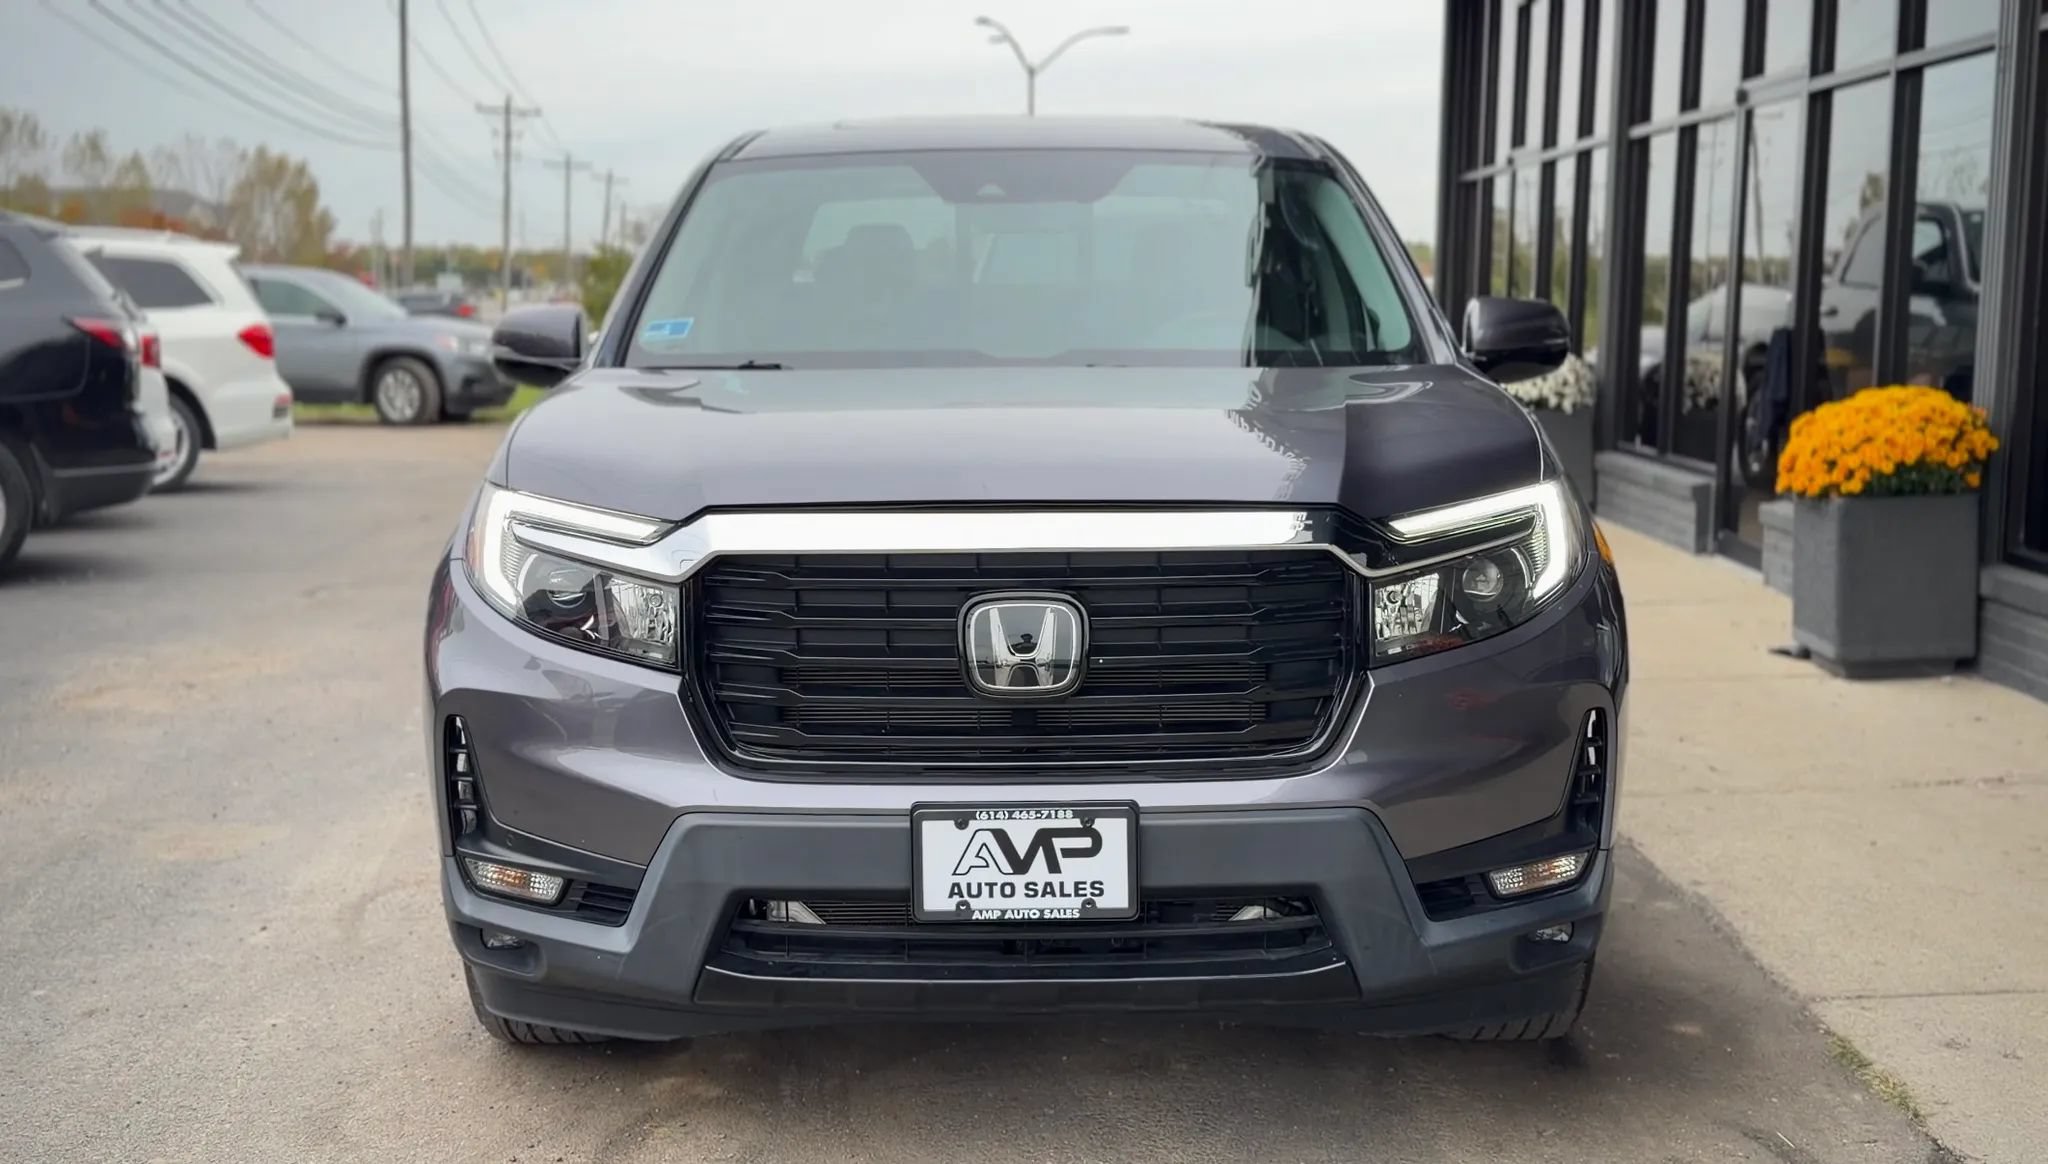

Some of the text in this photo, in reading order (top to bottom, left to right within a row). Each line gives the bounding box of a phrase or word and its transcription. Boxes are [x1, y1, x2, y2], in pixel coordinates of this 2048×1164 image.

[976, 809, 1074, 820] (614) 465-7188
[952, 827, 1103, 876] AMP
[948, 880, 1105, 898] AUTO SALES
[971, 908, 1080, 920] AMP AUTO SALES
